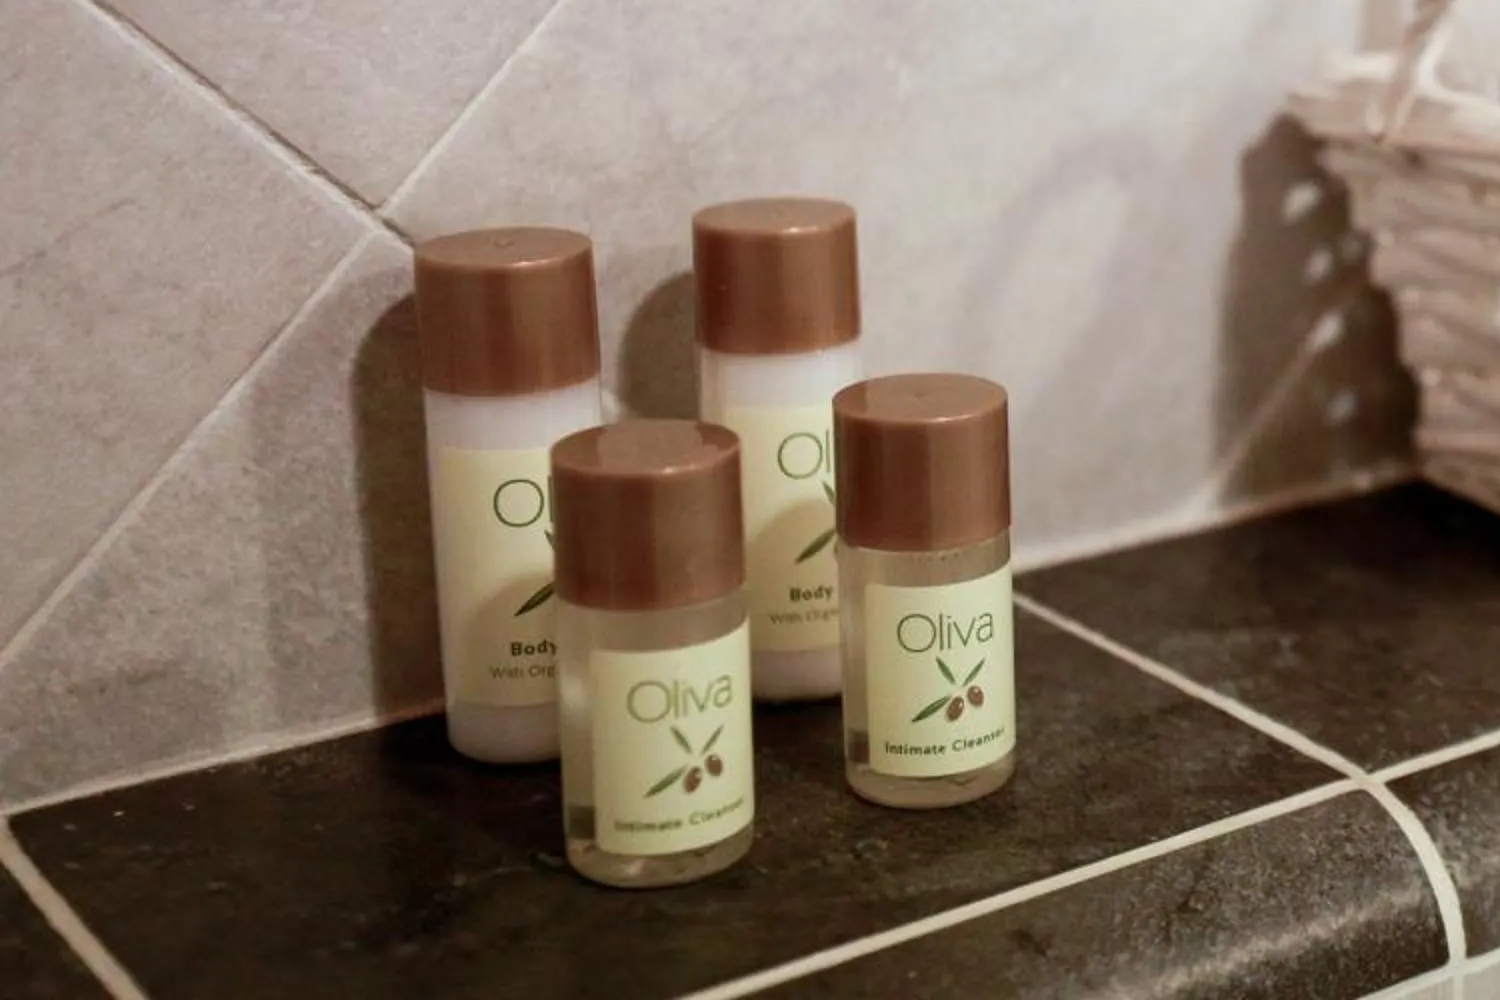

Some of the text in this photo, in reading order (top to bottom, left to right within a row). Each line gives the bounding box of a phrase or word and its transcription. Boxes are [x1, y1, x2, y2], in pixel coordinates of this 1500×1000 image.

[789, 584, 833, 603] Body
[897, 612, 993, 653] Oliva
[626, 674, 733, 724] Oliva
[885, 741, 947, 756] Intimate
